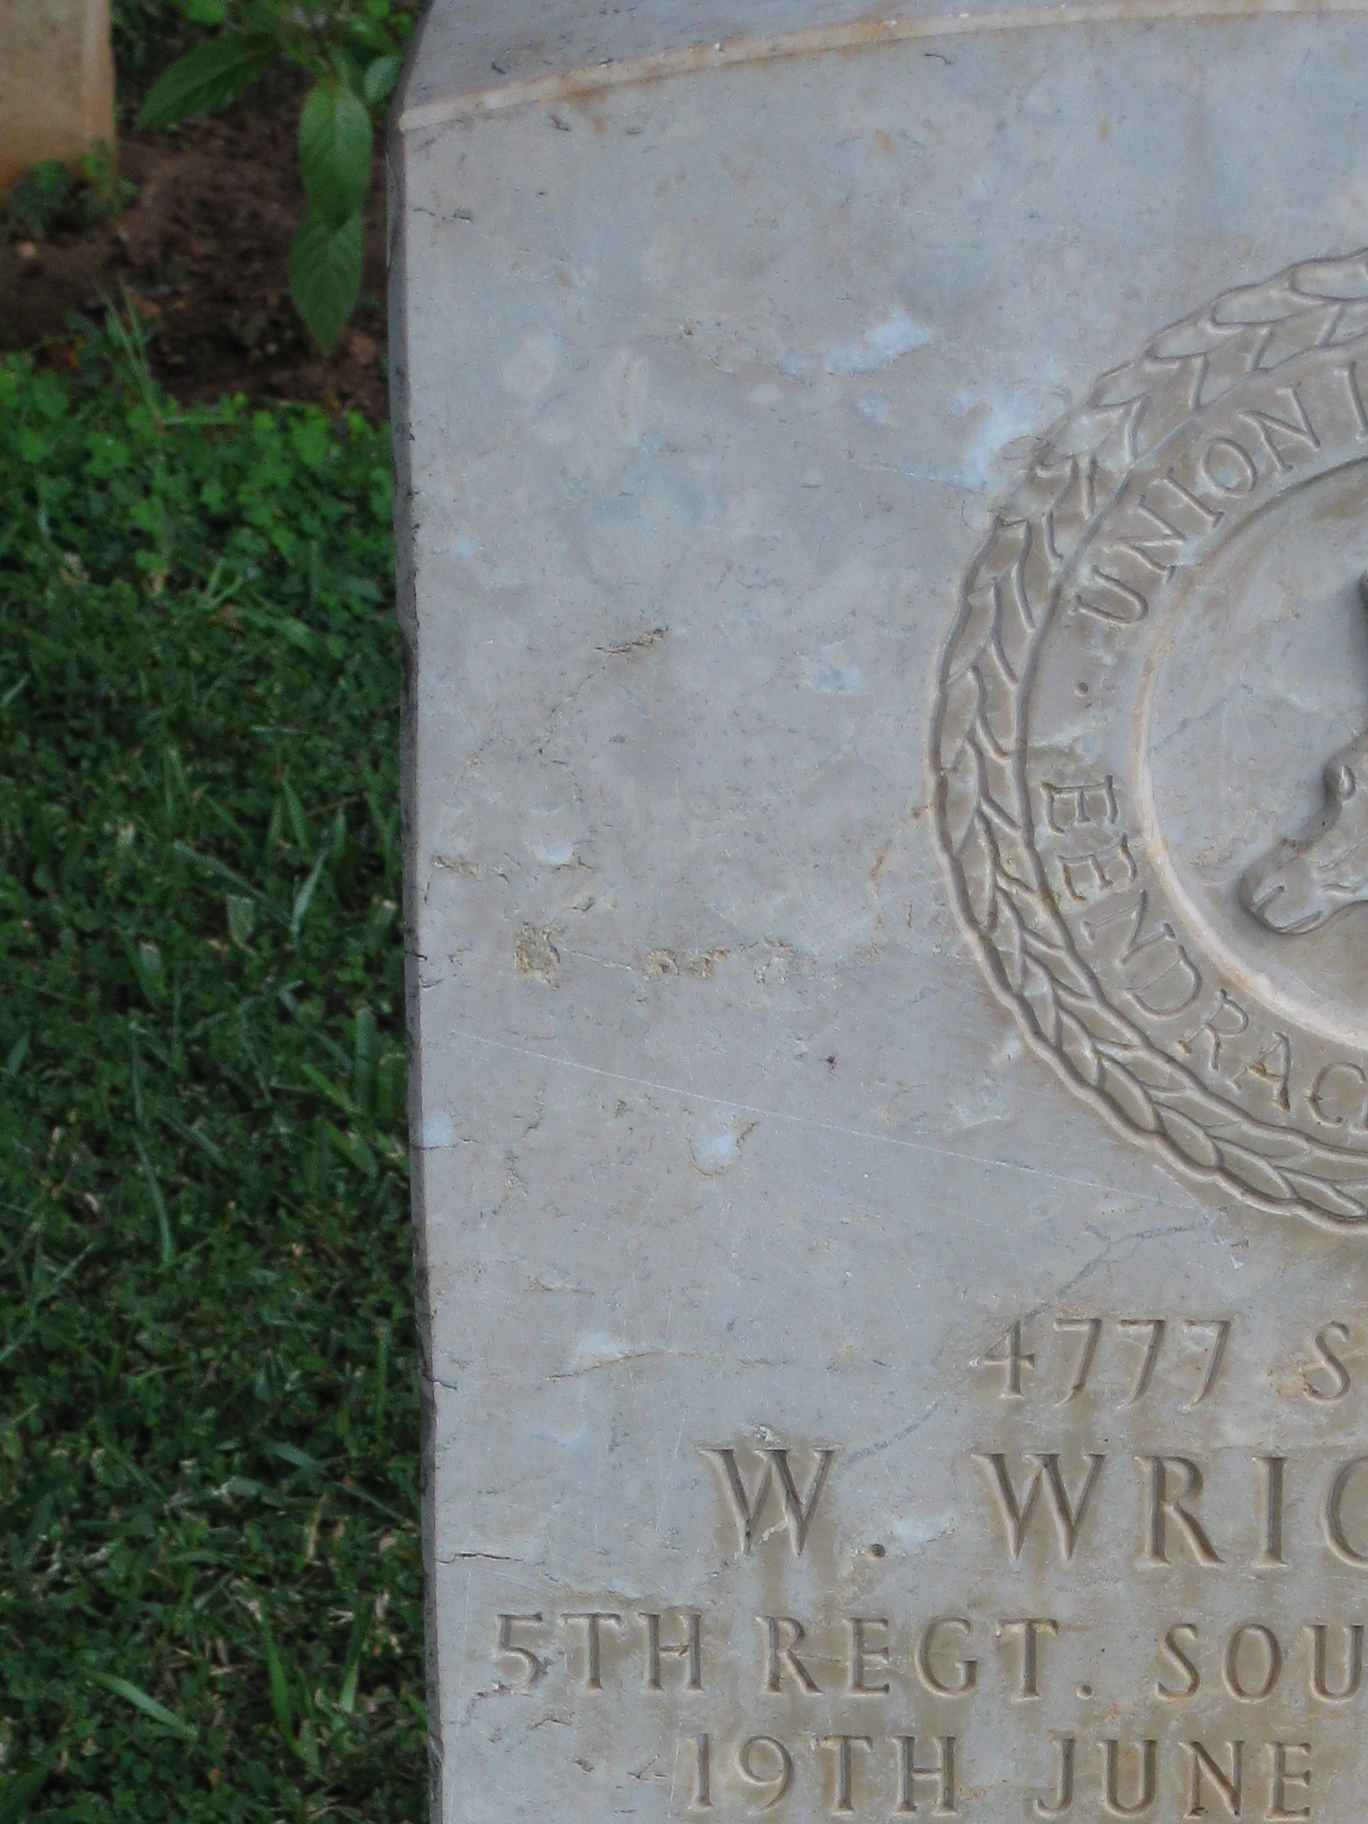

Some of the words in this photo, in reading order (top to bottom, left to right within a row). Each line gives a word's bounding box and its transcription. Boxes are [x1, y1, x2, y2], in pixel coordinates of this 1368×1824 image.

[1068, 382, 1320, 624] UNION
[978, 1318, 1232, 1407] 4777
[697, 1446, 887, 1560] W.
[493, 1611, 704, 1692] 5TH
[756, 1614, 1095, 1702] REGT.
[684, 1731, 958, 1815] 19TH
[1035, 1736, 1315, 1823] JUNE
